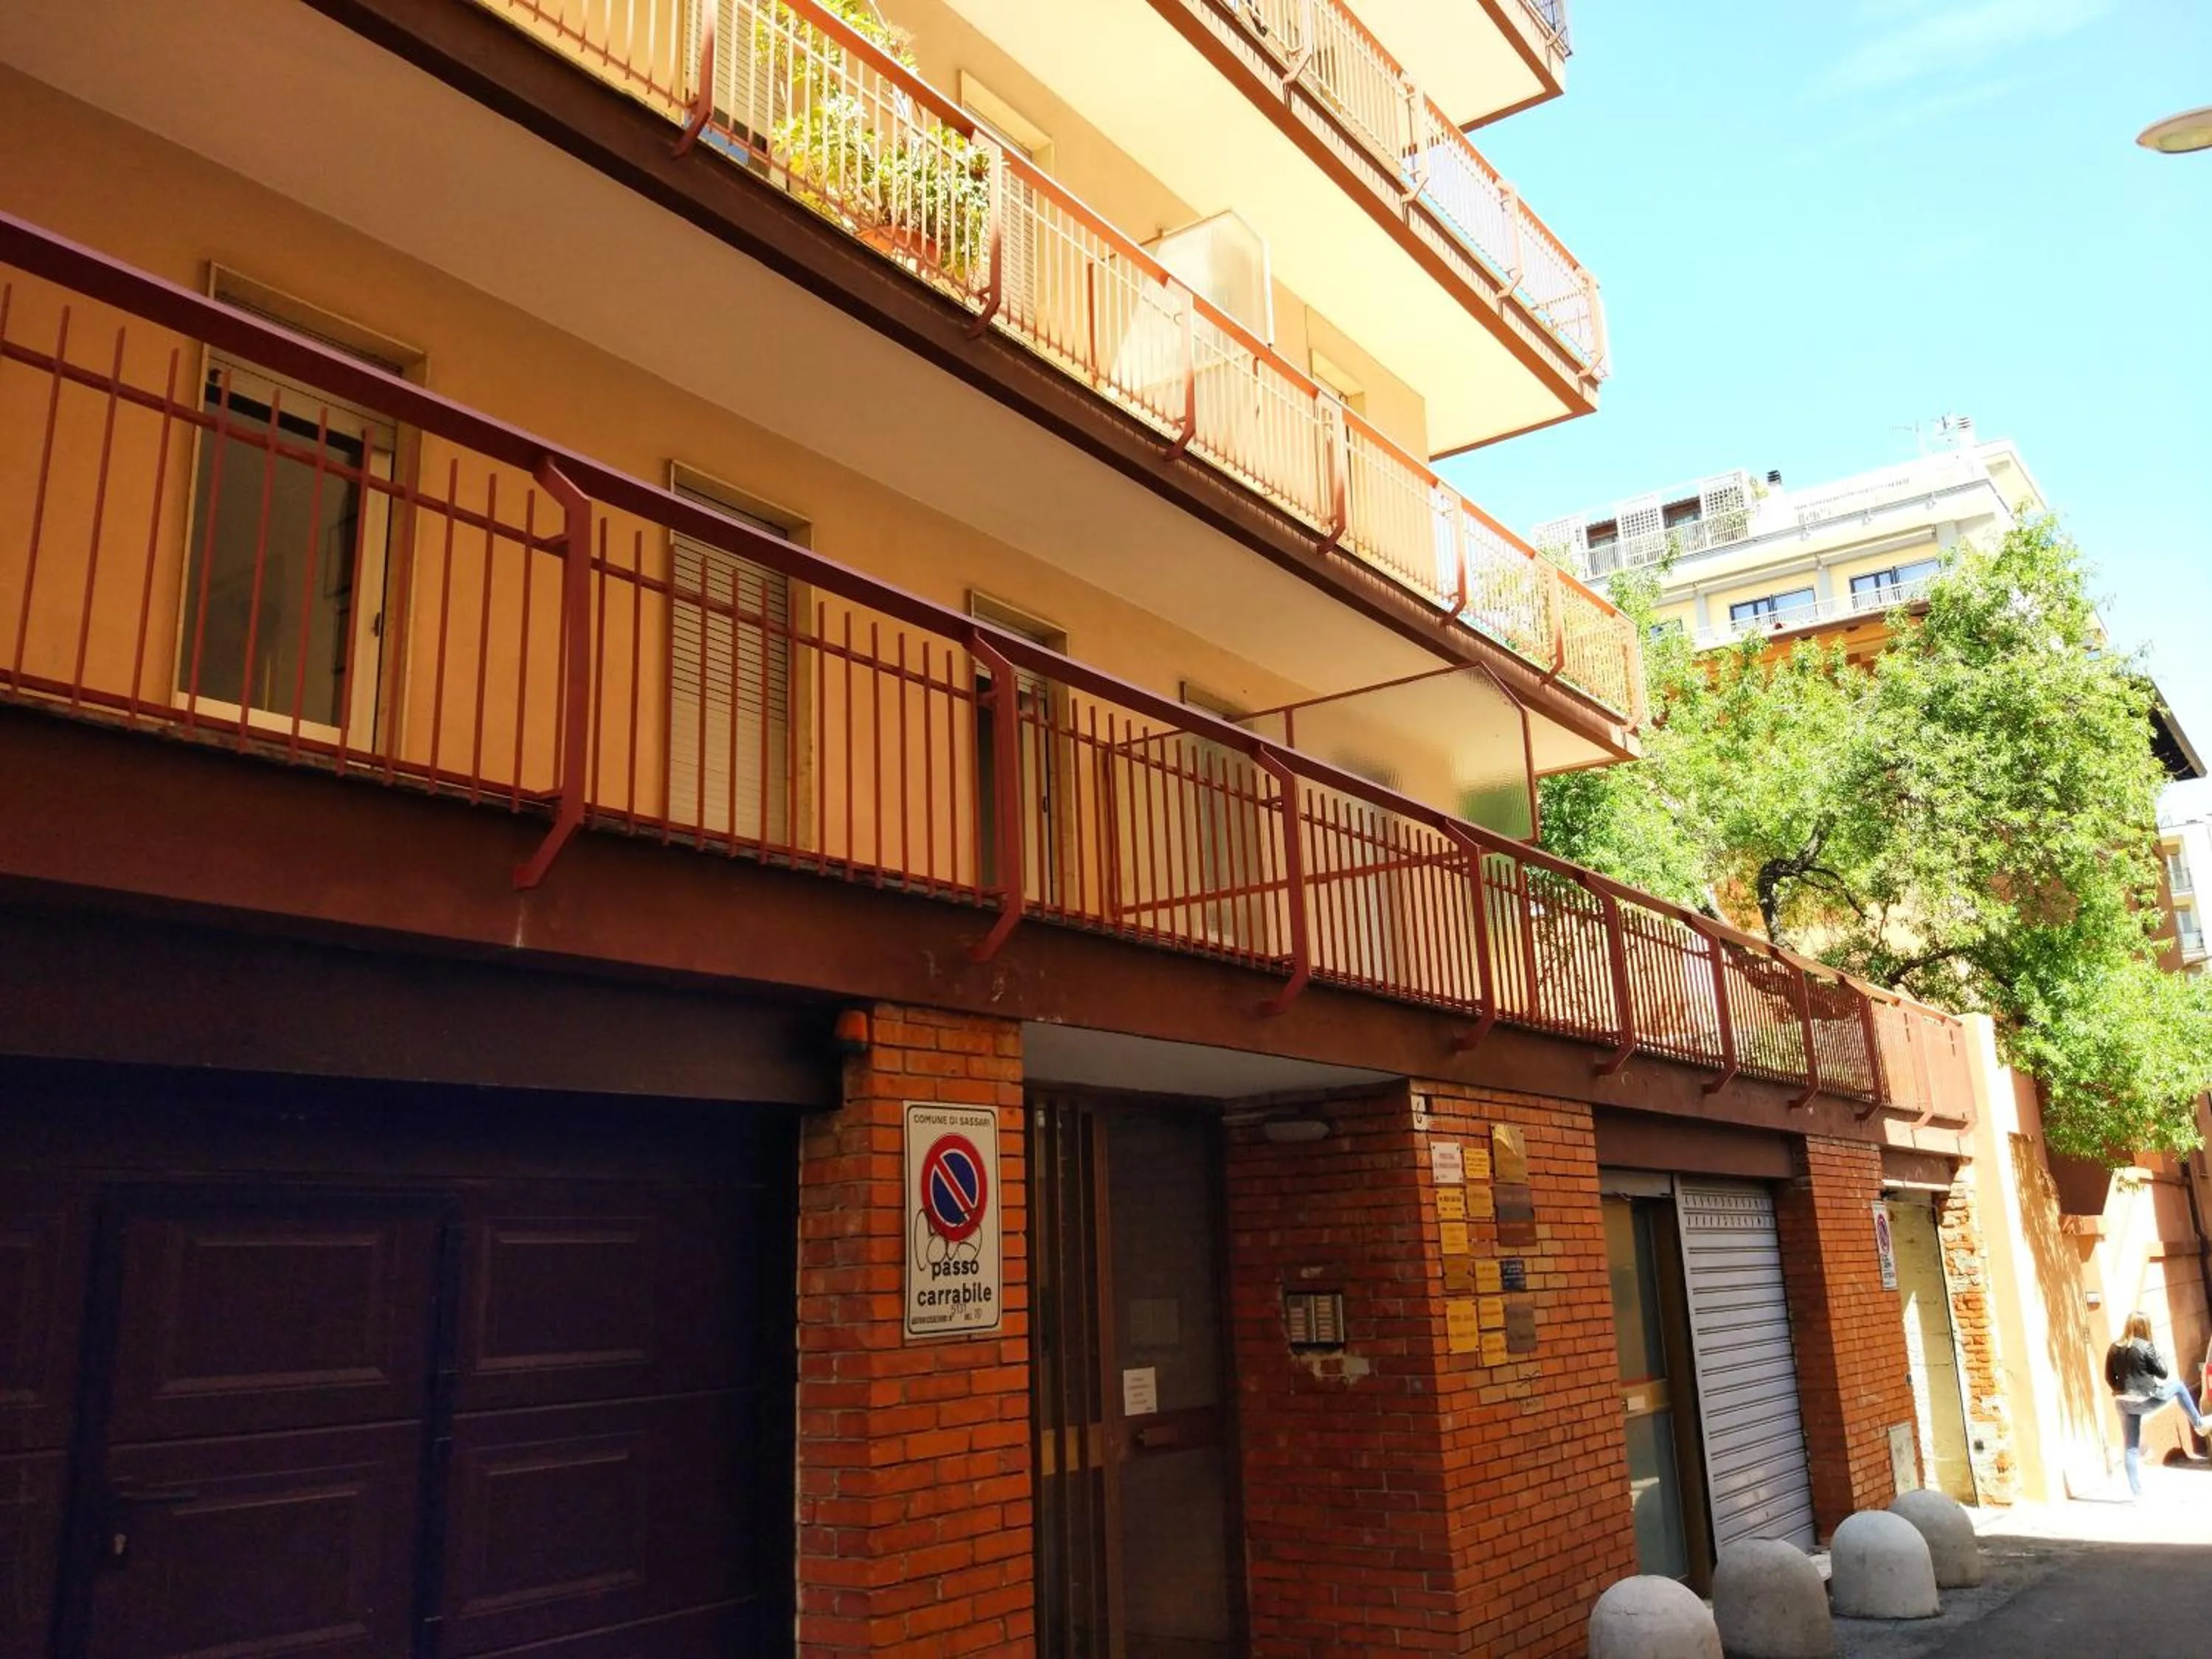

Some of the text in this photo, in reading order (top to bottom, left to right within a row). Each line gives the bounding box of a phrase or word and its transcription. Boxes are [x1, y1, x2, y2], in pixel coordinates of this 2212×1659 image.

[914, 1114, 990, 1127] COMUNE DI SASSARI
[931, 1259, 979, 1281] passo
[917, 1282, 992, 1307] carrabile
